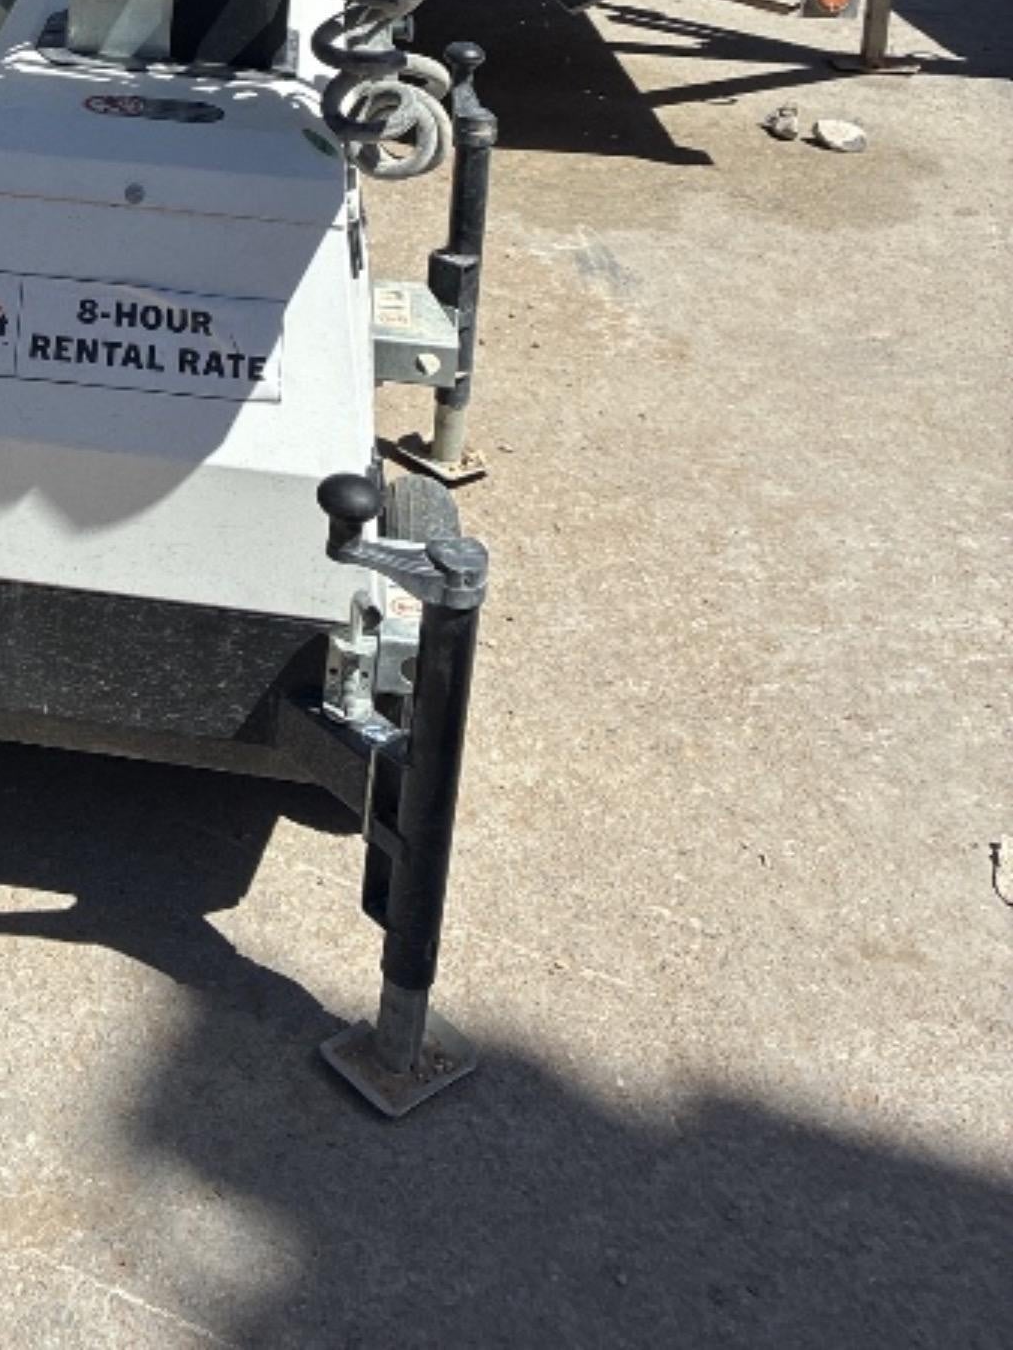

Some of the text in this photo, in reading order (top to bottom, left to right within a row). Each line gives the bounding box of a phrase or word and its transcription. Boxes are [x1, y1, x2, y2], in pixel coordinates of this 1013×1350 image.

[76, 298, 212, 336] 8-HOUR
[29, 333, 267, 382] RENTAL RATE
